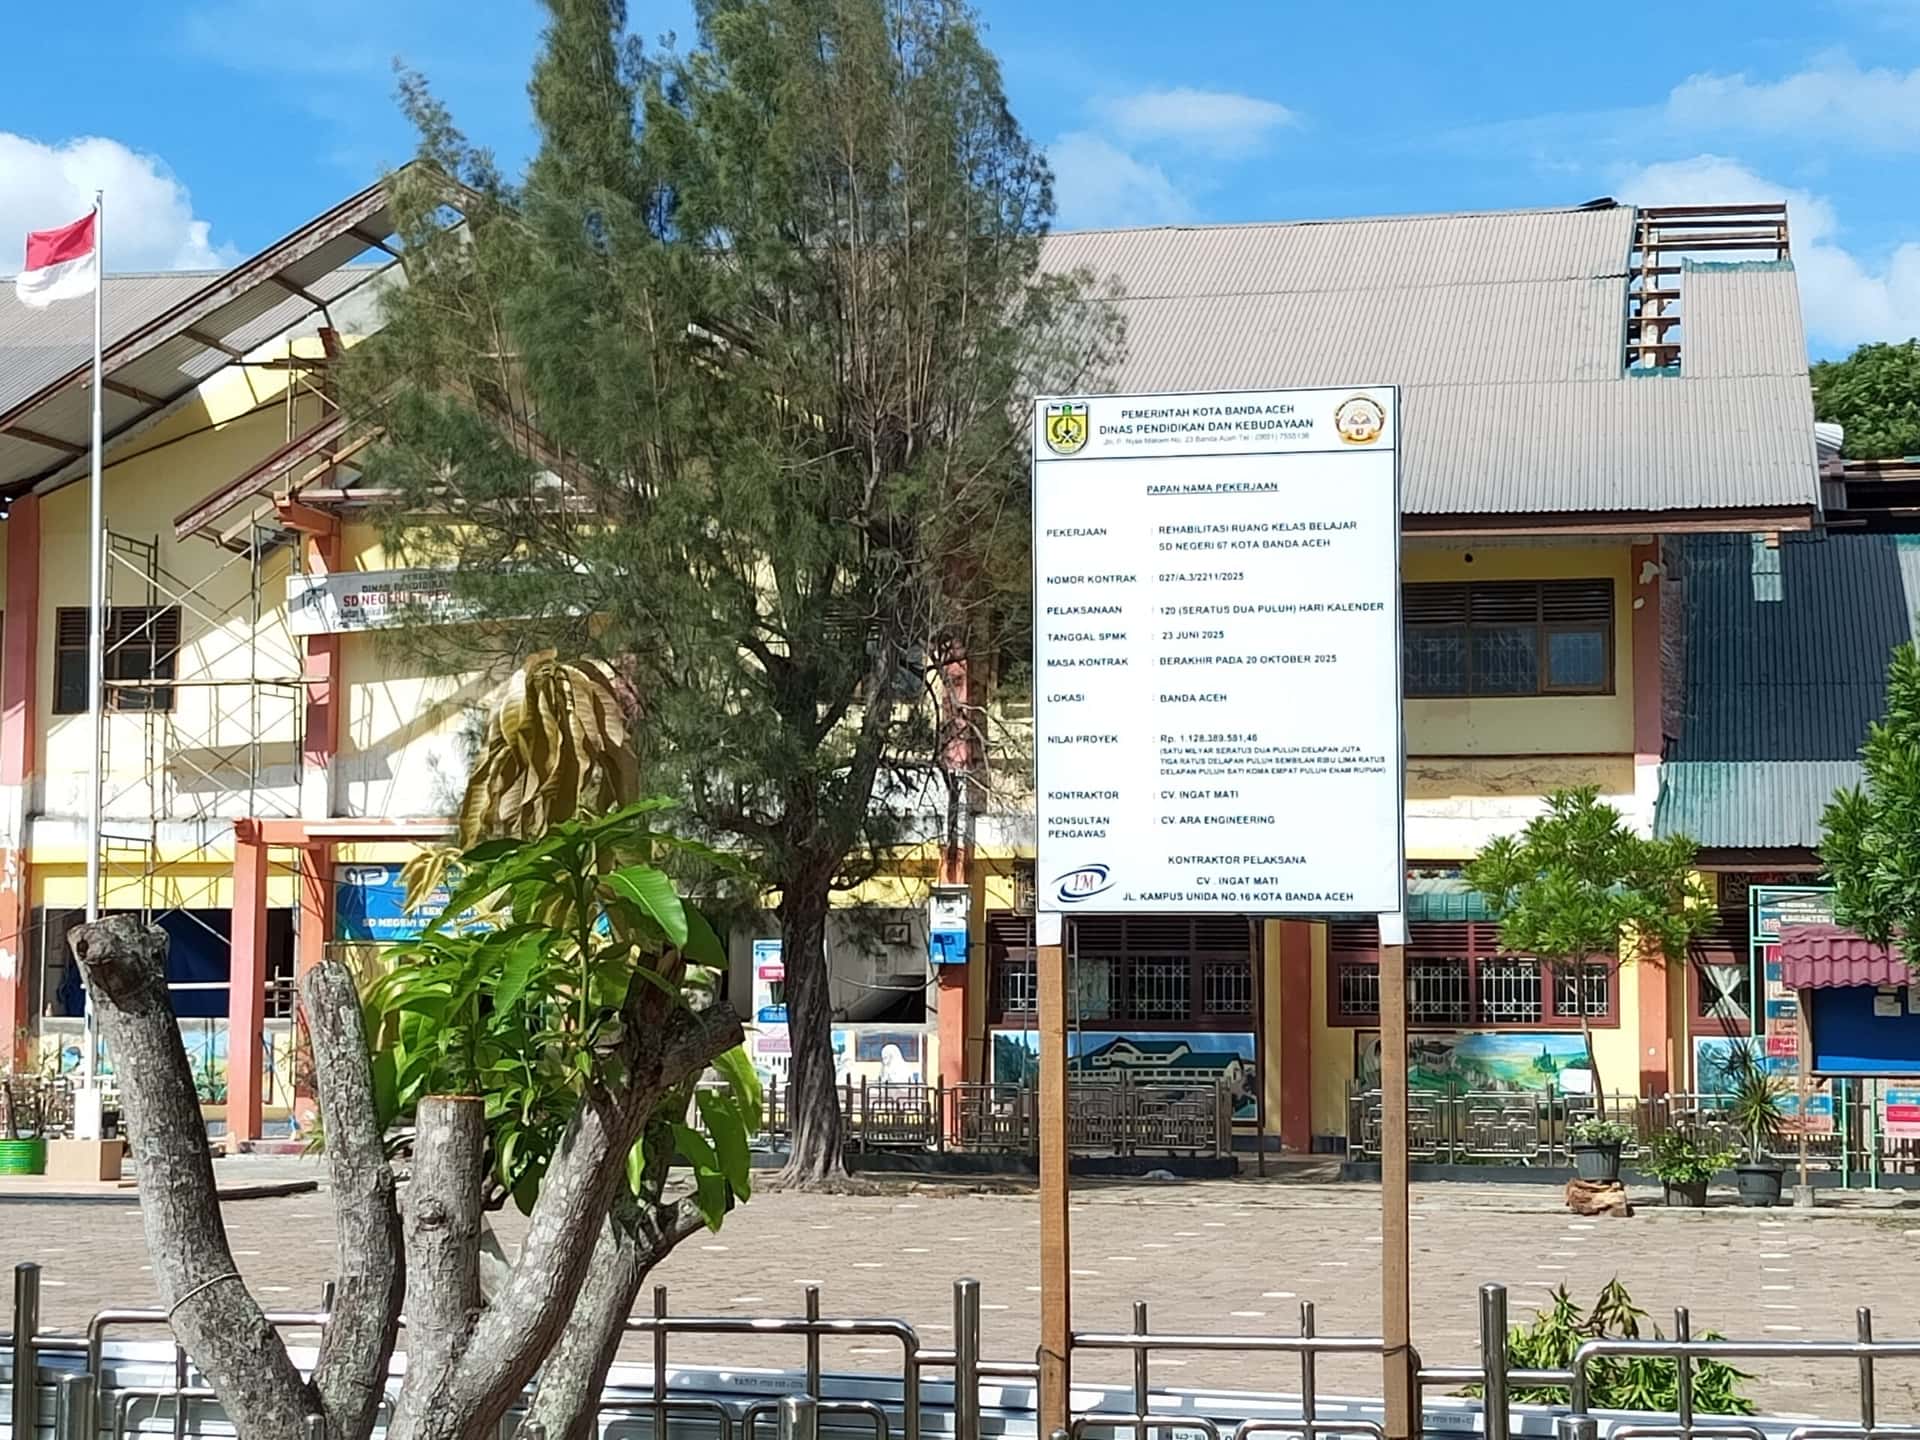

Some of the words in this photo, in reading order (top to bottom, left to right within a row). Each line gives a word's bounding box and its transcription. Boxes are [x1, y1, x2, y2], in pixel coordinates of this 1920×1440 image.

[1121, 408, 1190, 419] PEMERINTAH
[1192, 407, 1223, 417] KOTA
[1225, 405, 1264, 416] BANDA
[1265, 404, 1295, 414] ACEH
[1099, 424, 1134, 435] DINAS
[1136, 423, 1205, 434] PENDIDIKAN
[1208, 421, 1233, 432] DAN
[1235, 419, 1314, 431] KEBUDAYAAN
[1147, 485, 1181, 494] PAPAN
[1183, 484, 1214, 493] NAMA
[1216, 482, 1279, 492] PEKERJAAN
[1046, 528, 1108, 537] PEKERJAAN
[1158, 524, 1230, 534] REHABILITASI
[1232, 523, 1269, 533] RUANG
[1272, 522, 1307, 532] KELAS
[1309, 521, 1358, 531] BELAJAR
[1159, 542, 1172, 552] SD
[1176, 541, 1215, 551] NEGERI
[1217, 540, 1228, 550] 67
[1231, 540, 1260, 549] KOTA
[1262, 539, 1300, 549] BANDA
[1302, 538, 1331, 548] ACEH
[1047, 575, 1085, 585] NOMOR
[1087, 574, 1137, 584] KONTRAK
[343, 595, 359, 607] SD
[1047, 606, 1123, 615] PELAKSANAAN
[1160, 606, 1177, 616] 120
[1178, 605, 1231, 616] (SERATUS
[1233, 605, 1256, 614] DUA
[1257, 604, 1297, 614] PULUH)
[1299, 603, 1325, 612] HARI
[1327, 602, 1385, 612] KALENDER
[1048, 633, 1096, 642] TANGGAL
[1099, 632, 1128, 641] SPMK
[1162, 631, 1174, 640] 23
[1176, 631, 1200, 640] JUNI
[1202, 630, 1225, 640] 2025
[1047, 658, 1076, 667] MASA
[1079, 657, 1129, 667] KONTRAK
[1160, 656, 1213, 666] BERAKHIR
[1216, 655, 1244, 665] PADA
[1246, 655, 1258, 665] 20
[1260, 655, 1312, 664] OKTOBER
[1314, 654, 1337, 664] 2025
[1047, 693, 1085, 703] LOKASI
[1160, 693, 1197, 703] BANDA
[1199, 693, 1228, 703] ACEH
[1048, 735, 1074, 744] NILAI
[1076, 735, 1119, 744] PROYEK
[1216, 747, 1253, 755] SERATUS
[1273, 746, 1300, 754] PULUH
[1301, 746, 1339, 754] DELAPAN
[1340, 745, 1361, 753] JUTA
[1180, 757, 1206, 765] RATUS
[1208, 757, 1245, 765] DELAPAN
[1246, 757, 1273, 765] PULUH
[1317, 756, 1337, 764] RIBU
[1338, 756, 1357, 764] LIMA
[1160, 768, 1197, 776] DELAPAN
[1271, 767, 1298, 775] EMPAT
[1300, 767, 1328, 775] PULUH
[1048, 791, 1120, 800] KONTRAKTOR
[1179, 790, 1212, 799] INGAT
[1214, 790, 1239, 799] MATI
[1048, 816, 1110, 825] KONSULTAN
[1179, 815, 1202, 825] ARA
[1204, 815, 1276, 825] ENGINEERING
[1048, 829, 1107, 839] PENGAWAS
[1168, 855, 1241, 865] KONTRAKTOR
[1243, 855, 1307, 865] PELAKSANA
[1218, 876, 1251, 886] INGAT
[1254, 876, 1279, 885] MATI
[1140, 892, 1184, 901] KAMPUS
[1186, 892, 1219, 901] UNIDA
[1253, 892, 1283, 901] KOTA
[1285, 892, 1322, 902] BANDA
[1325, 892, 1354, 902] ACEH
